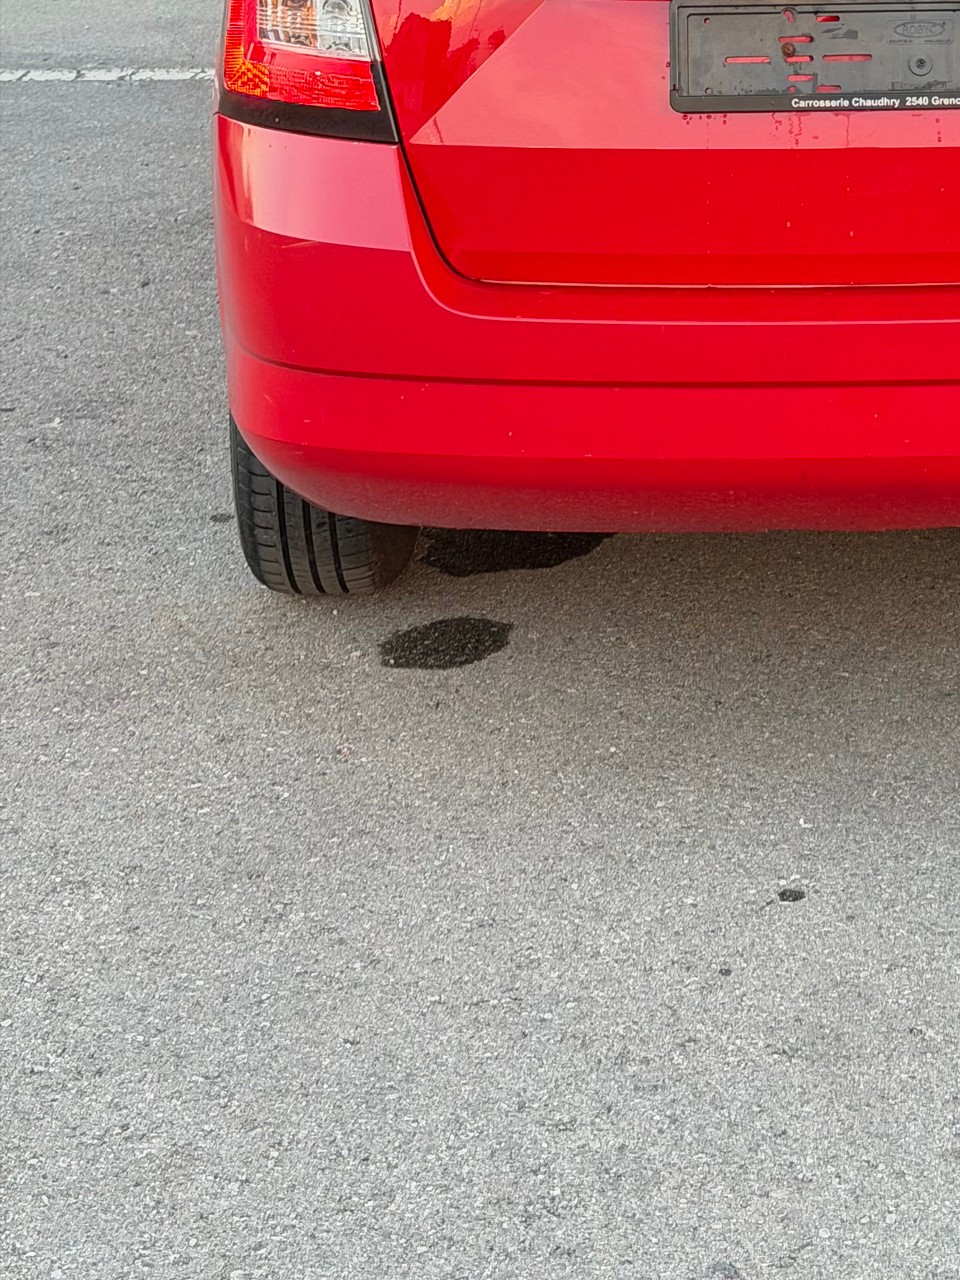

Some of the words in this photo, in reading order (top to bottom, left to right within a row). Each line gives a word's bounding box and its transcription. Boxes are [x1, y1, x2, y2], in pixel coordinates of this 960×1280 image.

[791, 97, 850, 108] Carrosserie
[851, 97, 901, 108] Chaudhry
[905, 96, 929, 106] 2540
